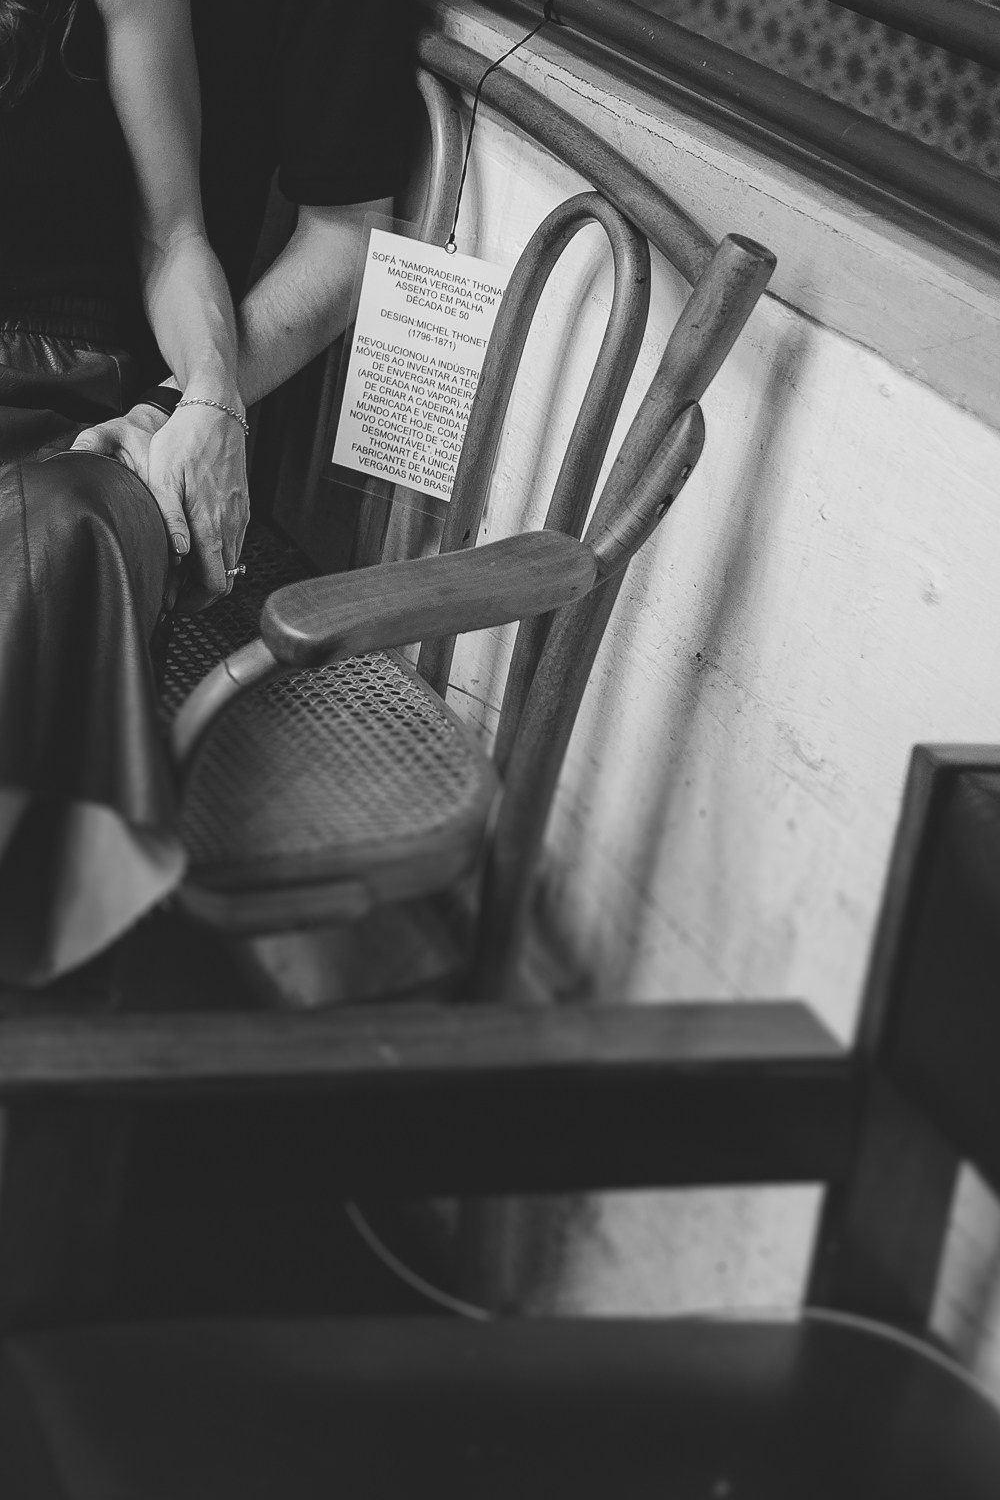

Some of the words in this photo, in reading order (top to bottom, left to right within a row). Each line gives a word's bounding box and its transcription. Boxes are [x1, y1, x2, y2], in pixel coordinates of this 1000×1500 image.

[372, 252, 396, 265] SOFÁ
[388, 267, 427, 285] MADEIRA
[430, 279, 472, 298] VERGADA
[474, 293, 495, 305] COM
[396, 281, 438, 299] ASSENTO
[440, 294, 454, 304] EM
[456, 298, 484, 314] PALHA
[406, 295, 442, 312] DÉCADA
[444, 306, 457, 316] DE
[459, 311, 469, 320] 50
[358, 335, 428, 364] REVOLUCIONOU
[430, 358, 436, 366] A
[408, 329, 456, 351] (1796-1871)
[452, 331, 487, 348] THONET
[356, 346, 390, 361] MÓVEIS
[391, 357, 404, 366] AO
[407, 361, 450, 381] INVENTAR
[451, 376, 458, 384] A
[372, 362, 385, 371] DE
[387, 366, 436, 388] ENVERGAR
[358, 368, 410, 392] (ARQUEADA
[411, 385, 425, 395] NO
[362, 392, 412, 414] FABRICADA
[414, 408, 420, 416] E
[422, 410, 461, 430] VENDIDA
[365, 381, 377, 391] DE
[379, 385, 406, 400] CRIAR
[408, 396, 414, 404] A
[416, 398, 454, 416] CADEIRA
[350, 410, 375, 424] NOVO
[378, 418, 423, 439] CONCEITO
[425, 434, 438, 444] DE
[356, 400, 390, 417] MUNDO
[391, 413, 408, 424] ATÉ
[410, 418, 435, 433] HOJE,
[437, 427, 458, 440] COM
[351, 442, 406, 467] FABRICANTE
[408, 462, 420, 471] DE
[358, 456, 407, 479] VERGADAS
[408, 473, 422, 483] NO
[369, 437, 411, 458] THONART
[412, 450, 419, 460] É
[420, 455, 426, 463] A
[428, 456, 455, 473] ÚNICA
[434, 448, 458, 462] HOJE
